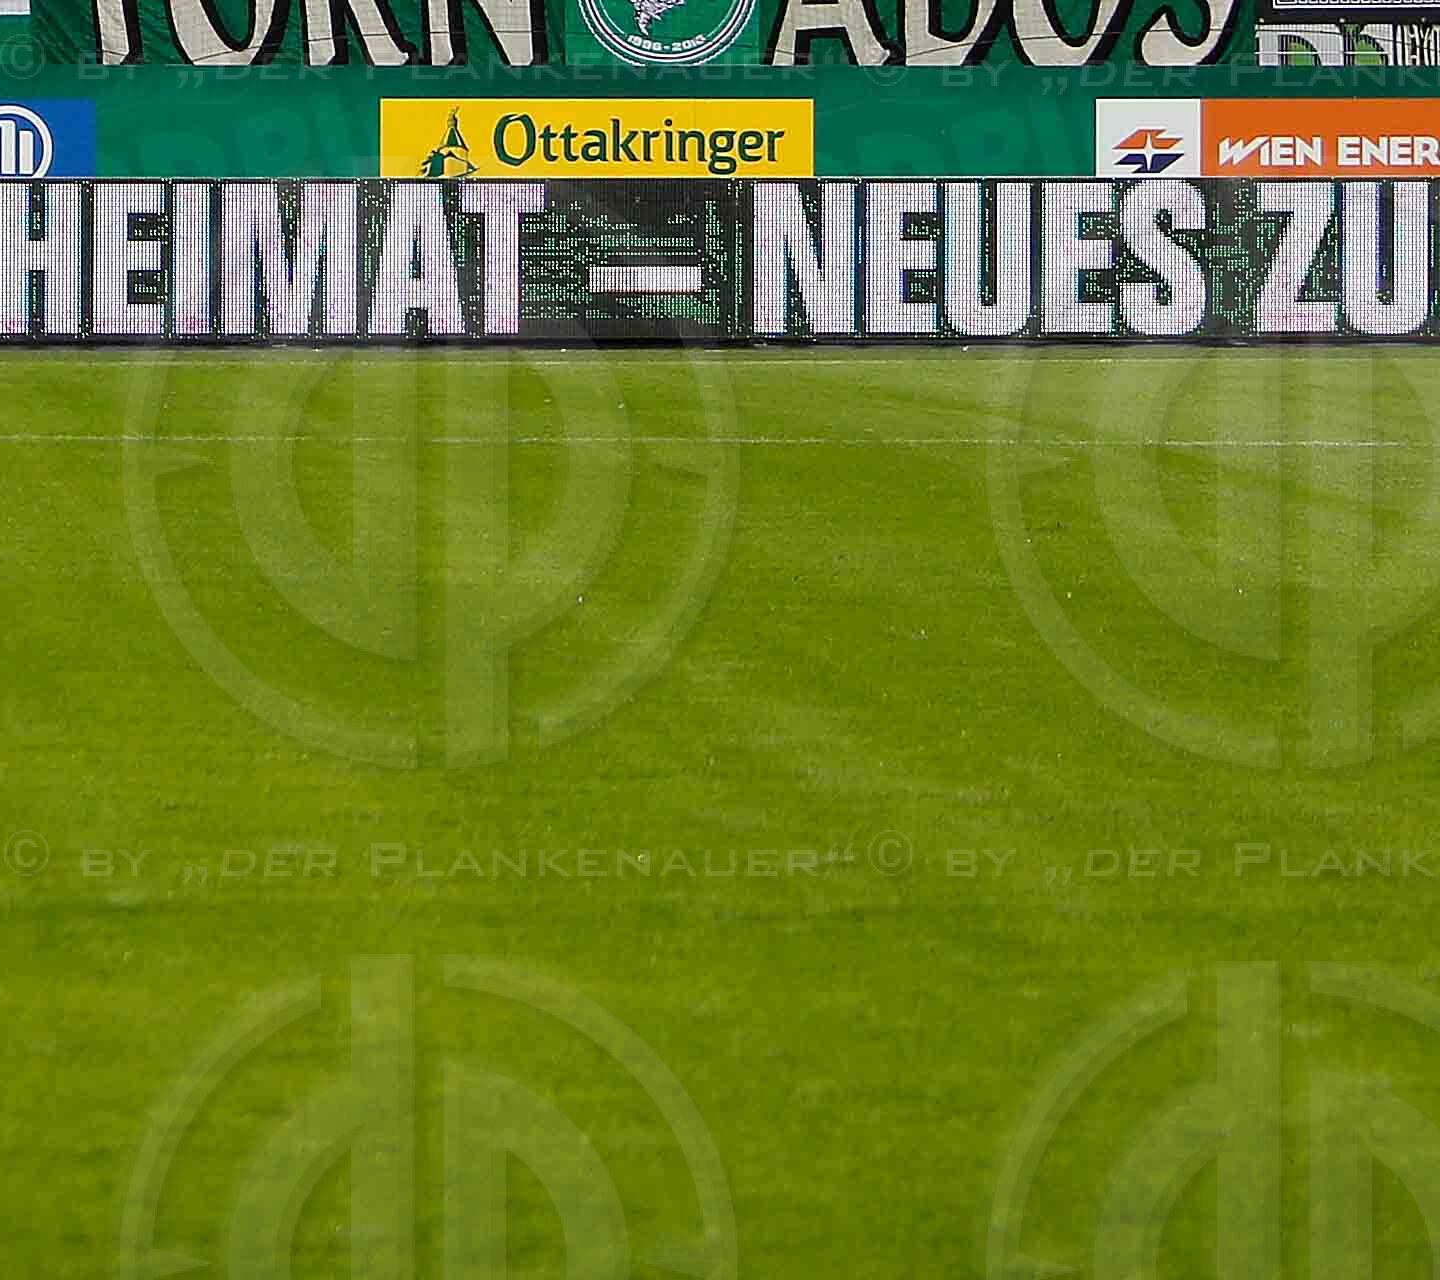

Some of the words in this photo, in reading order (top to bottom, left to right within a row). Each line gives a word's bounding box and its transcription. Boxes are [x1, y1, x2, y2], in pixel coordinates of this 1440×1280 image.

[492, 111, 786, 172] Ottakringer
[1218, 135, 1330, 168] WIEN
[750, 181, 1207, 336] NEUES
